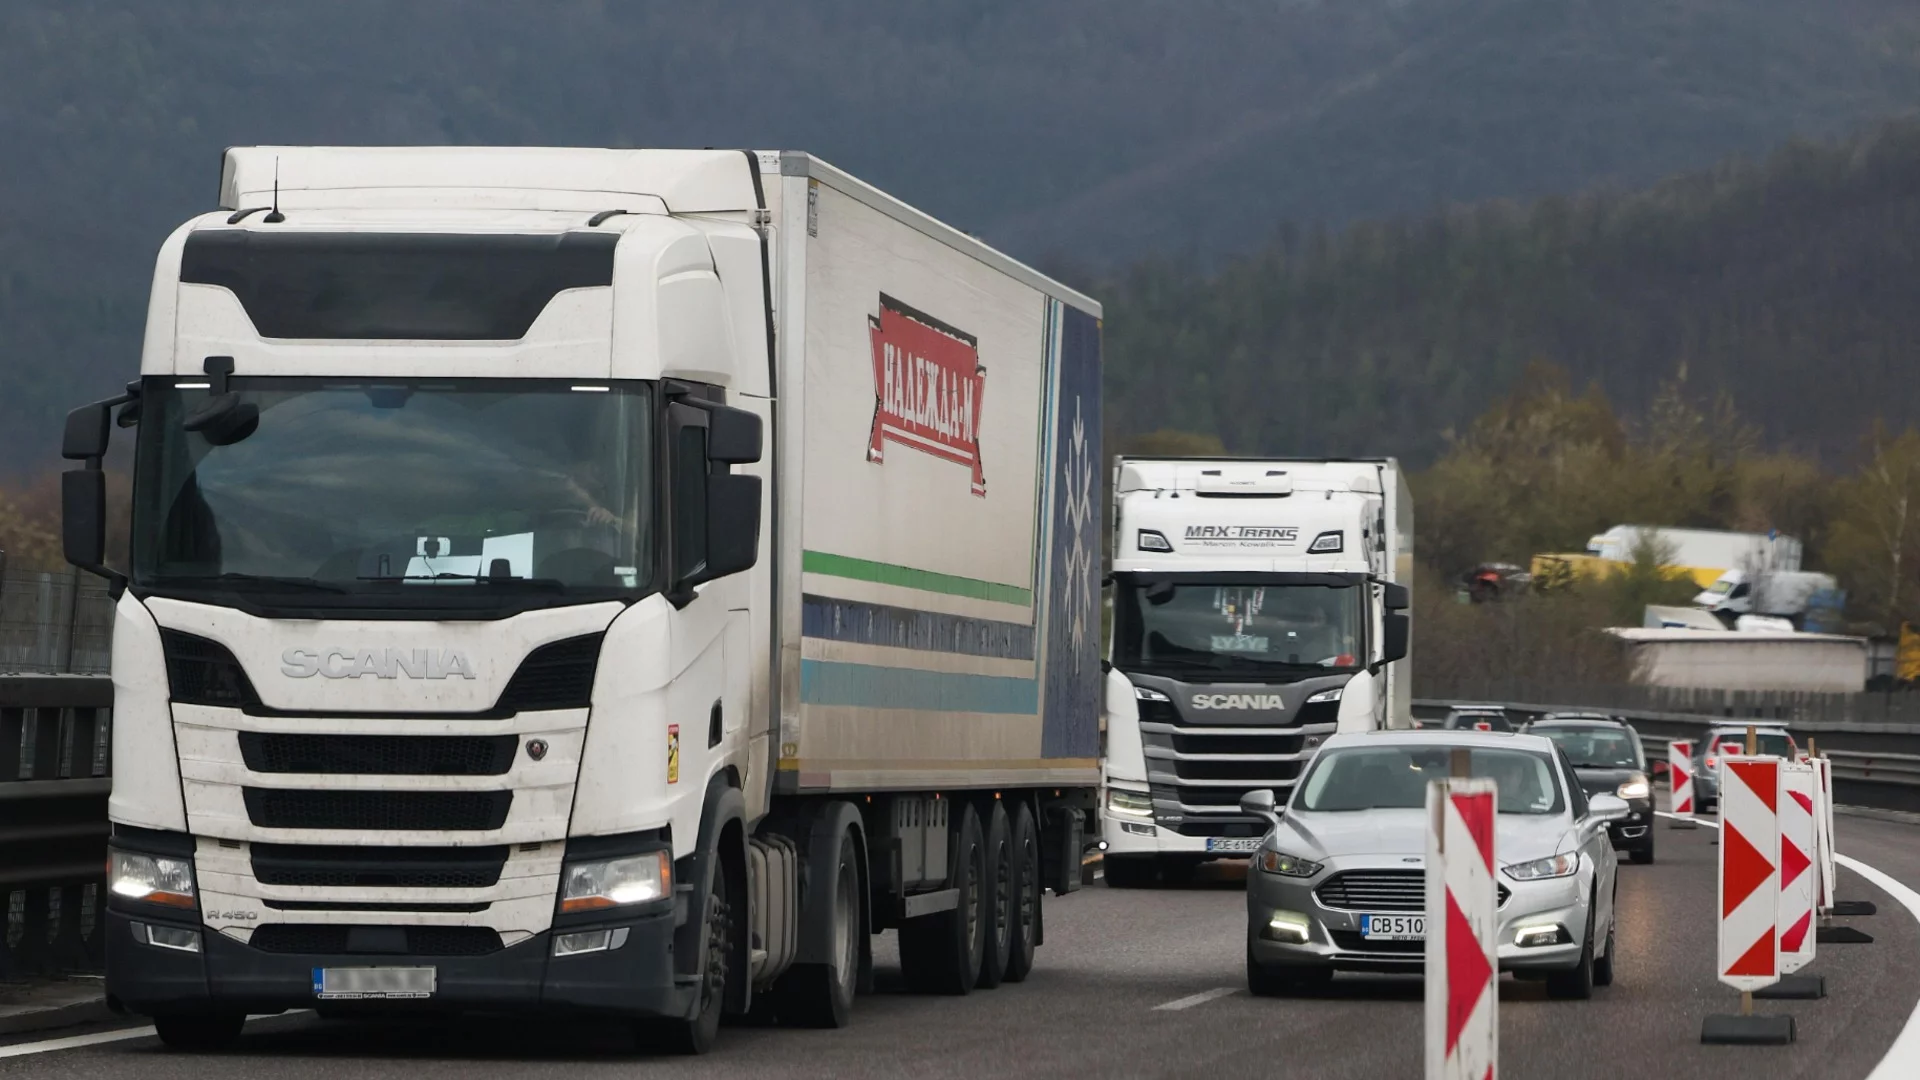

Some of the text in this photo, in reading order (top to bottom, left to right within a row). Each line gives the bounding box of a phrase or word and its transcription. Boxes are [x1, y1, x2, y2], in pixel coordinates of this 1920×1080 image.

[883, 341, 974, 444] НАДЕЖДА-М
[281, 647, 476, 680] SCANIA
[1191, 694, 1285, 710] SCANIA
[207, 910, 258, 920] R 450
[1371, 917, 1427, 933] CB 510
